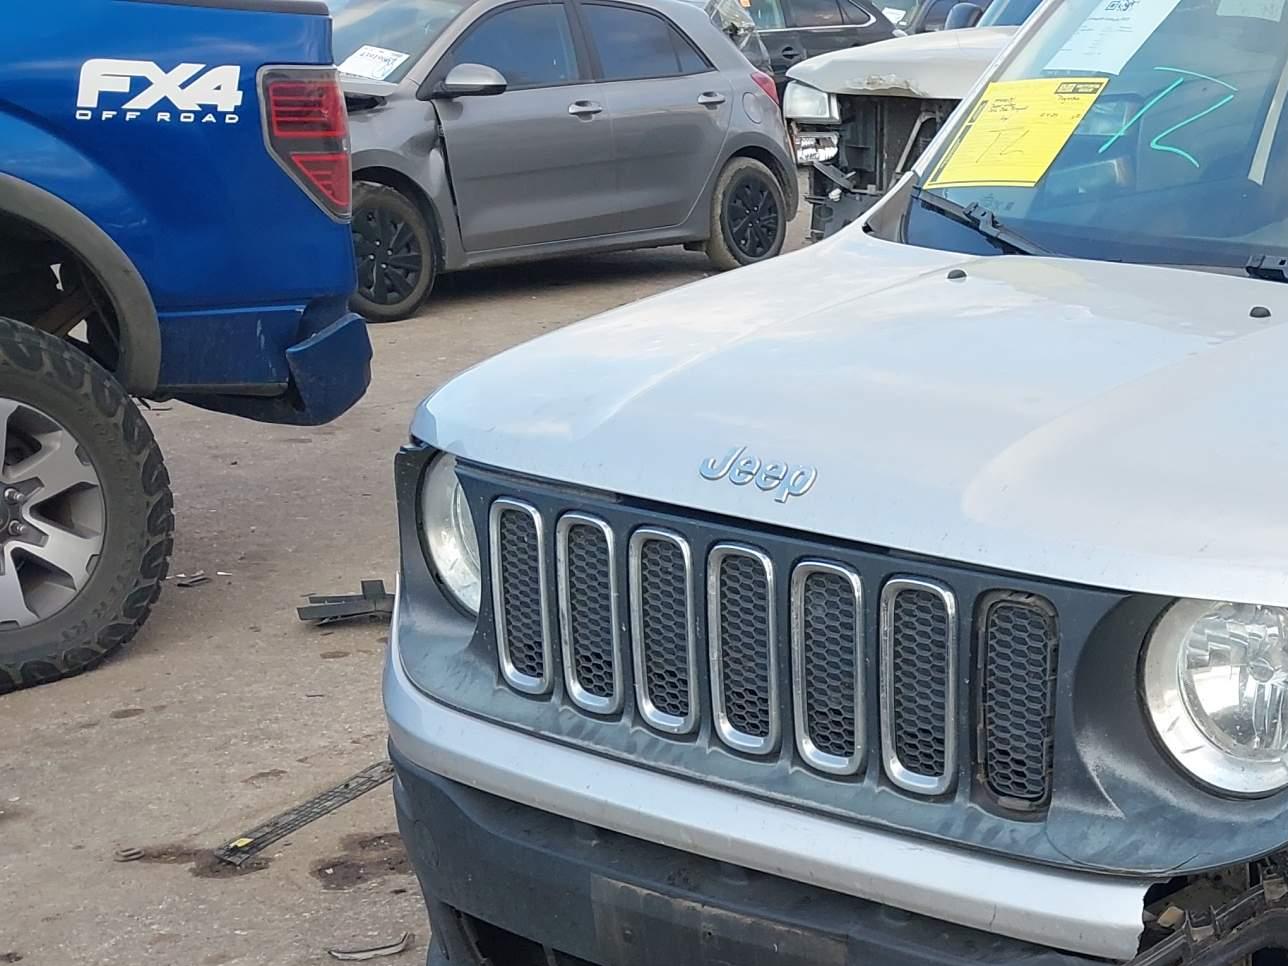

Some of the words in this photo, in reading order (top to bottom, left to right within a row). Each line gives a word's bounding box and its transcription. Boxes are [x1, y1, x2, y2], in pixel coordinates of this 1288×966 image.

[76, 58, 243, 112] FX4
[75, 110, 142, 122] OFF
[156, 111, 239, 124] ROAD
[699, 446, 818, 504] Jeep
